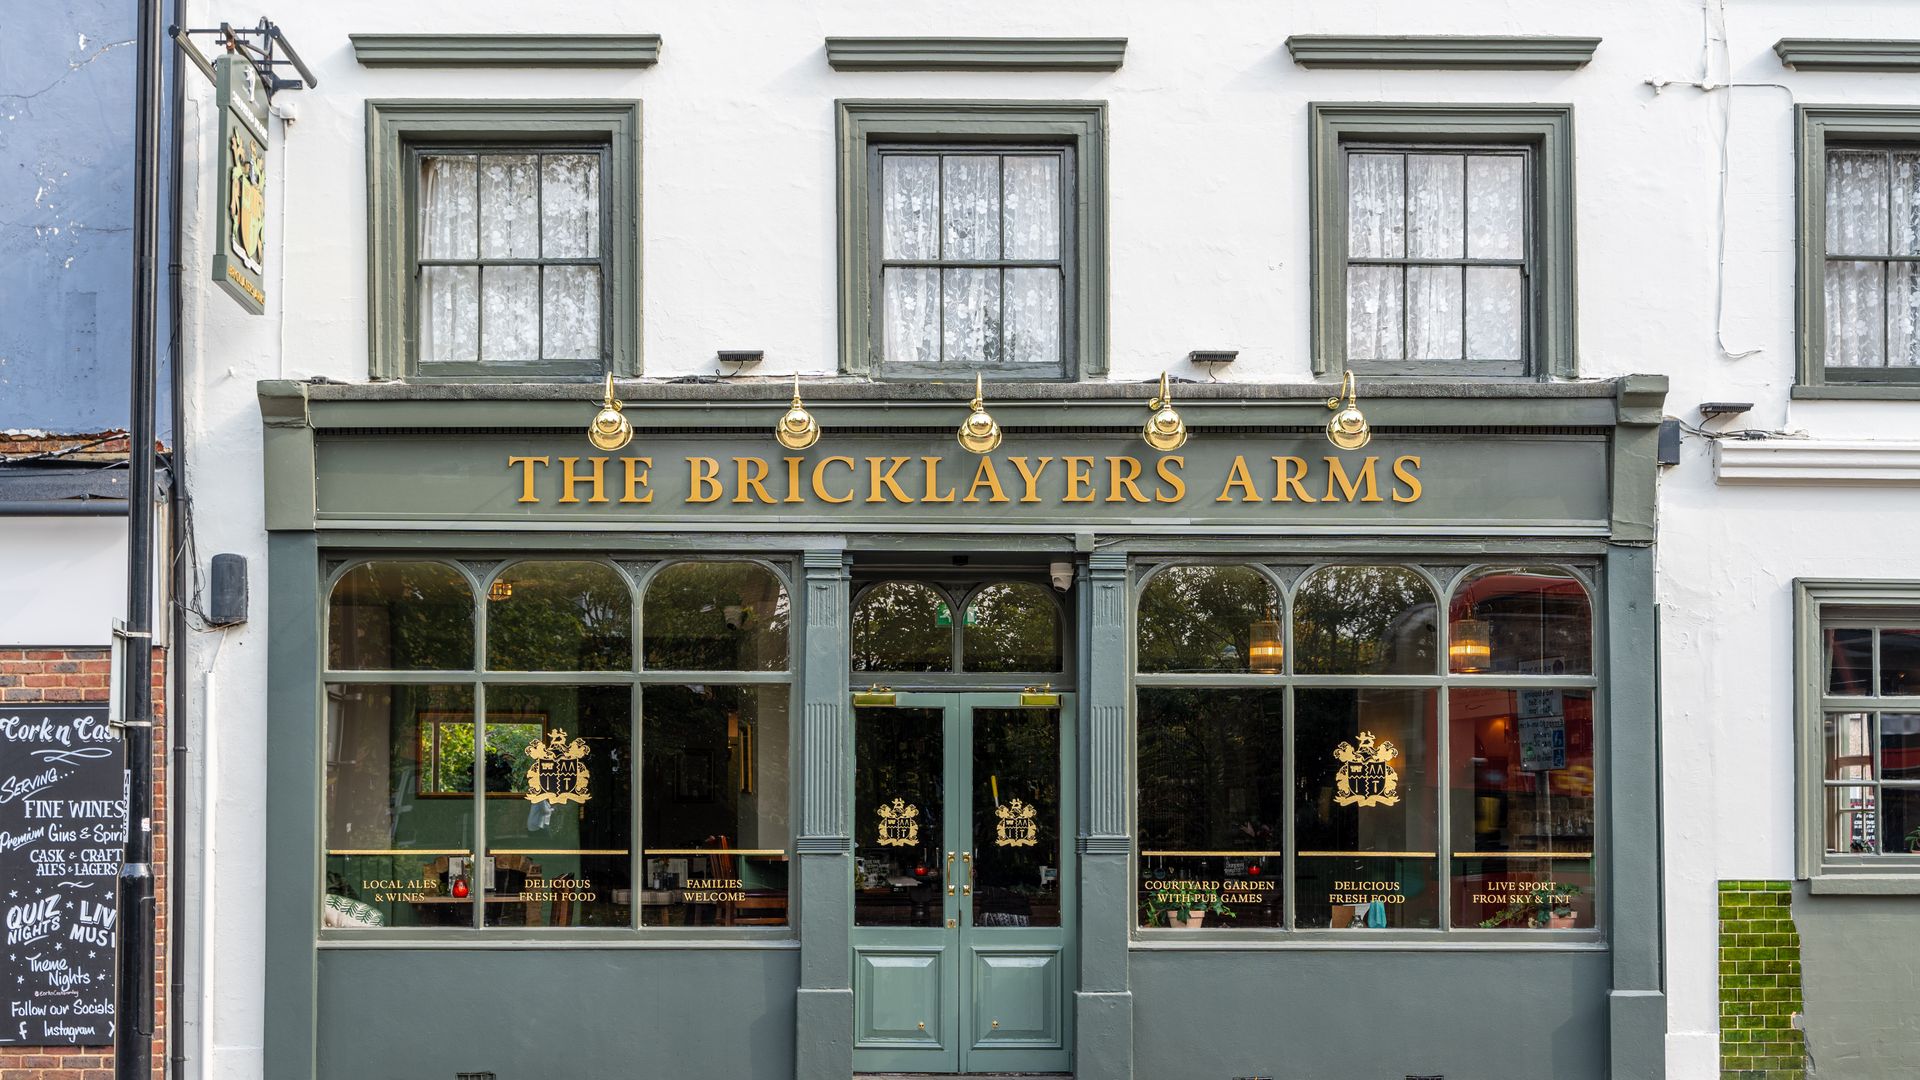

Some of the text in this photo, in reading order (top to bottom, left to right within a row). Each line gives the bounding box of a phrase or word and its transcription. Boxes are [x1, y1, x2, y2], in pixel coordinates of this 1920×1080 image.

[508, 455, 1423, 503] THE BRICKLAYERS ARMS
[0, 716, 54, 742] Cork
[73, 716, 121, 742] Cas
[24, 800, 124, 819] FINE WINES
[0, 826, 45, 853] Premium
[48, 823, 77, 842] Gins
[93, 823, 122, 845] Spiri
[30, 849, 65, 863] CASK
[80, 848, 124, 862] CRAFT
[36, 863, 66, 876] ALES
[74, 863, 118, 876] LAGERS
[363, 879, 437, 890] LOCAL ALES
[524, 879, 591, 890] DELICIOUS
[686, 879, 743, 890] FAMILIES
[1144, 880, 1275, 891] COURTYARD GARDEN
[1334, 880, 1400, 891] DELICIOUS
[1487, 881, 1557, 892] LIVE SPORT
[375, 892, 425, 902] & WINES
[519, 892, 596, 903] FRESH FOOD
[684, 892, 746, 903] WELCOME
[1156, 893, 1263, 904] WITH PUB GAMES
[1329, 894, 1406, 905] FRESH FOOD
[1473, 894, 1571, 905] FROM SKY & TNT
[6, 893, 62, 930] QUIZ
[80, 900, 117, 930] LIV
[7, 916, 61, 945] NIGHTS
[69, 923, 116, 948] MUSI
[25, 953, 69, 972] Theme
[49, 966, 91, 991] Nights
[11, 998, 115, 1017] Follow our Socials
[44, 1020, 95, 1043] Instagram
